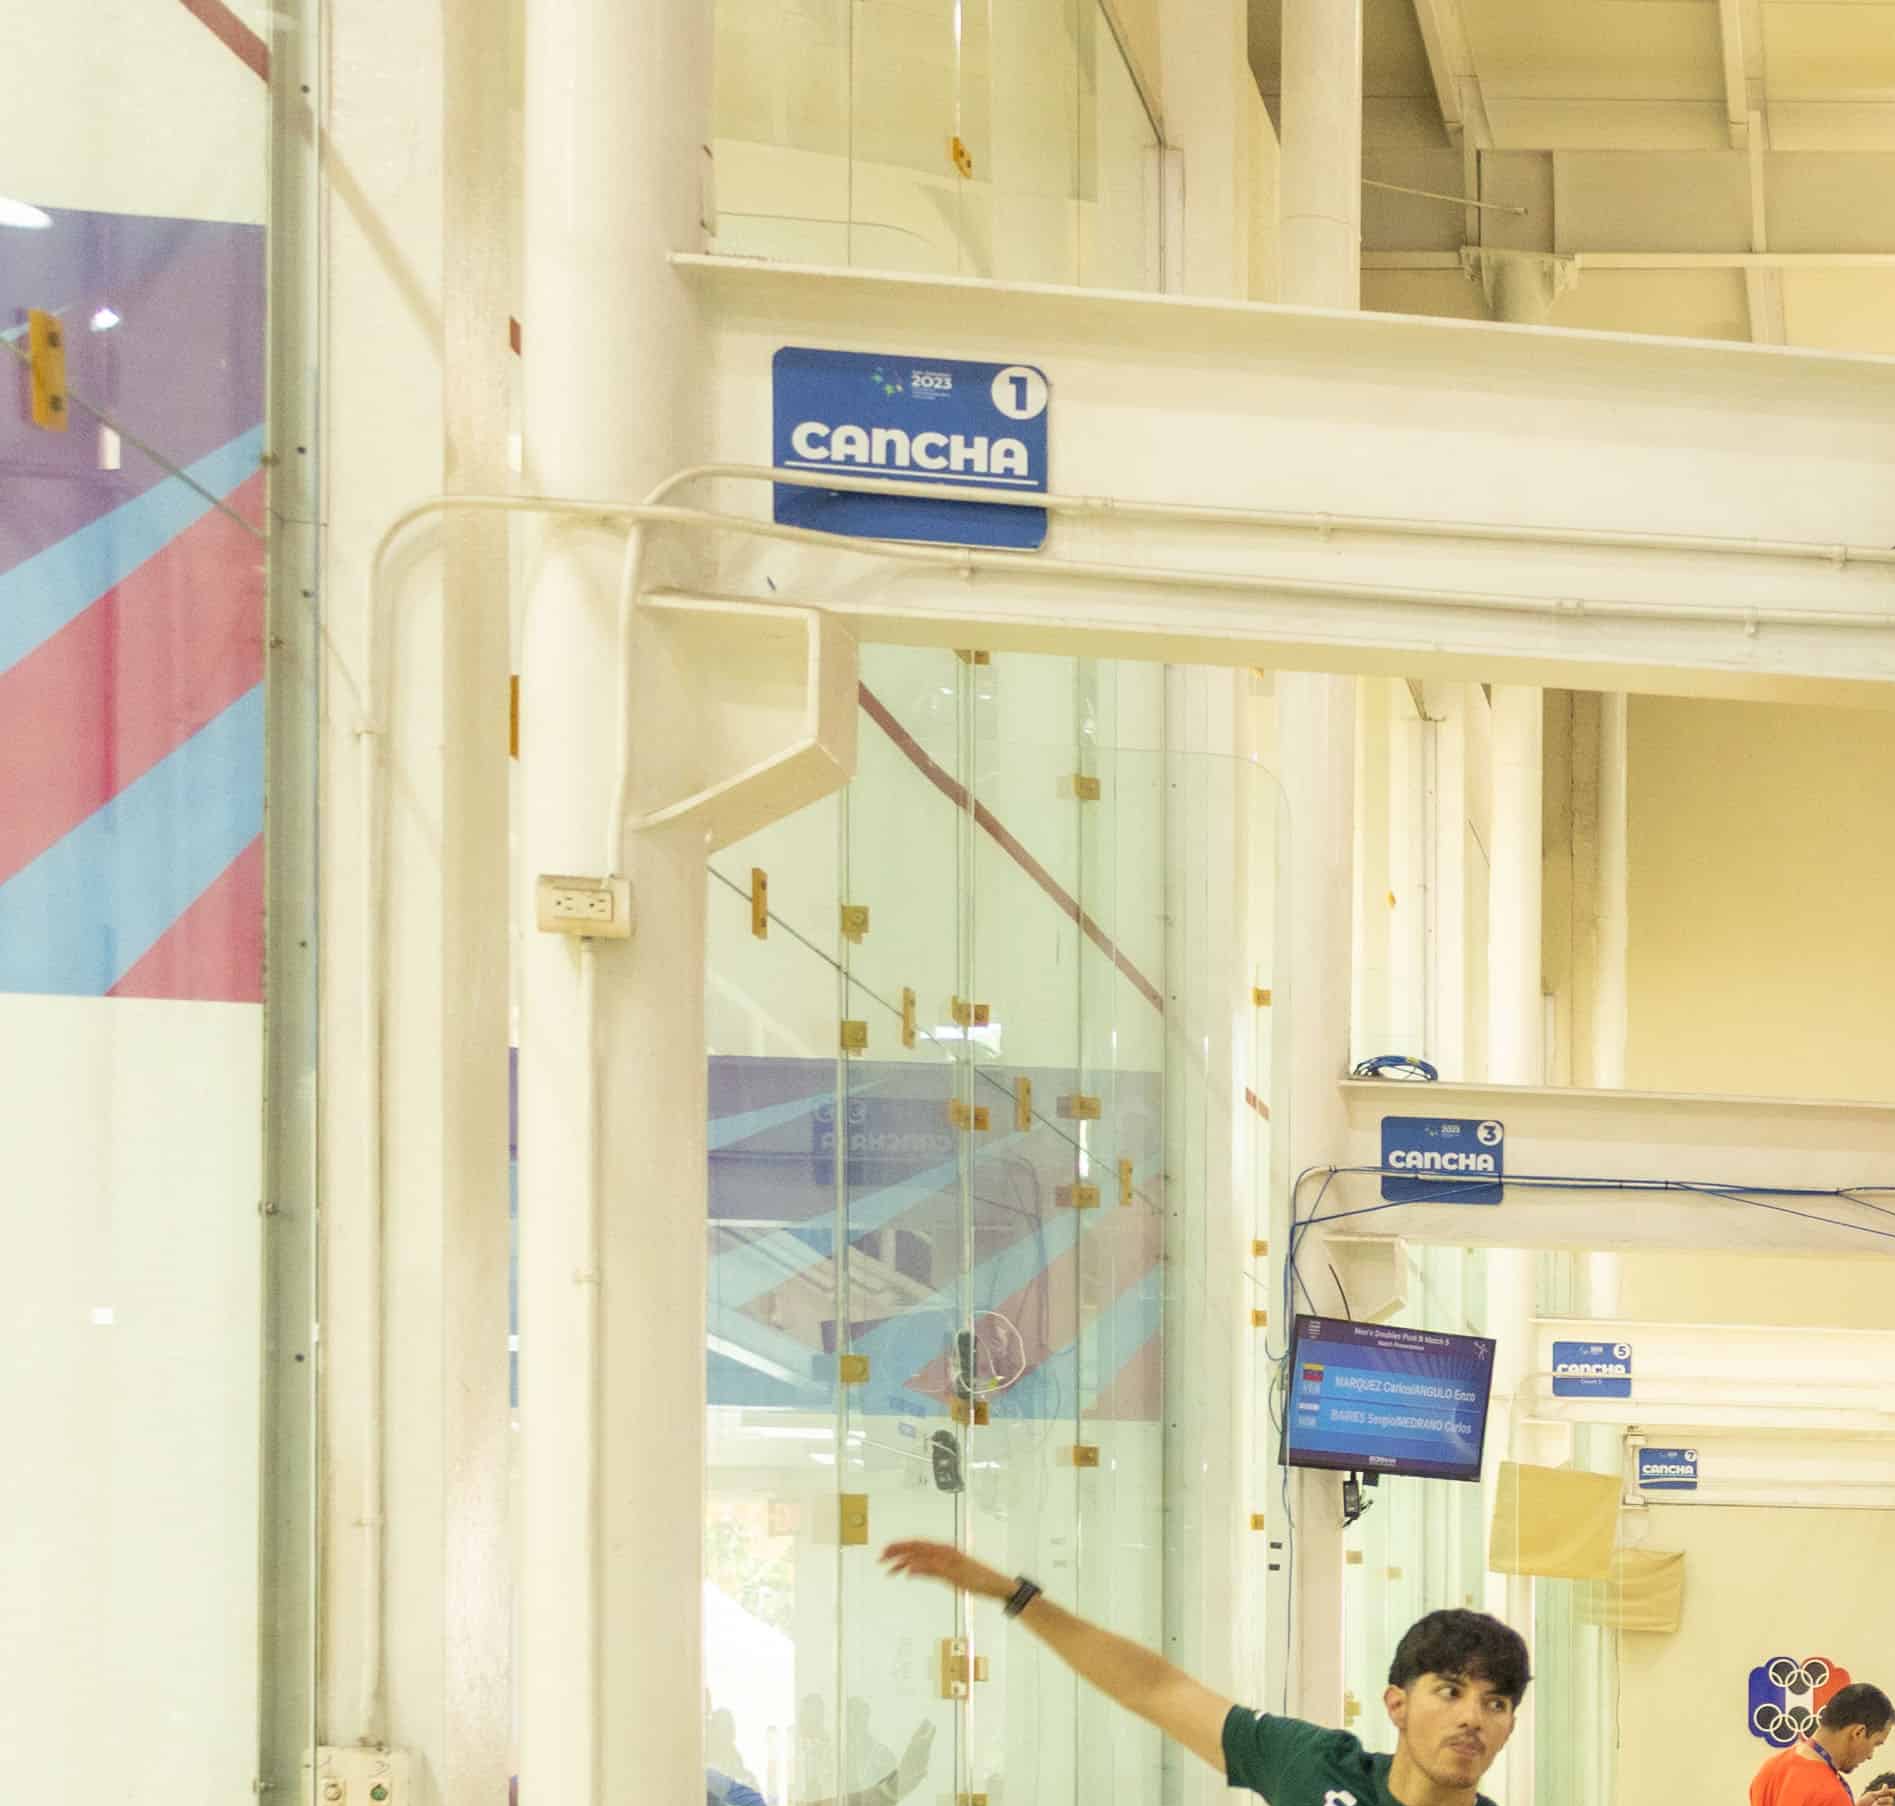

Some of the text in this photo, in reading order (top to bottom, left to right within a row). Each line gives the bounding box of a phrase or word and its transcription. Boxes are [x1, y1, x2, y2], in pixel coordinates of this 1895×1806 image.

[1008, 376, 1028, 412] 1
[791, 421, 1029, 477] CANCHA
[1483, 1125, 1497, 1142] 3
[1388, 1150, 1495, 1172] CANCHA
[1618, 1346, 1626, 1356] 5
[1557, 1363, 1626, 1376] CANCHA
[1642, 1463, 1694, 1475] CANCHA
